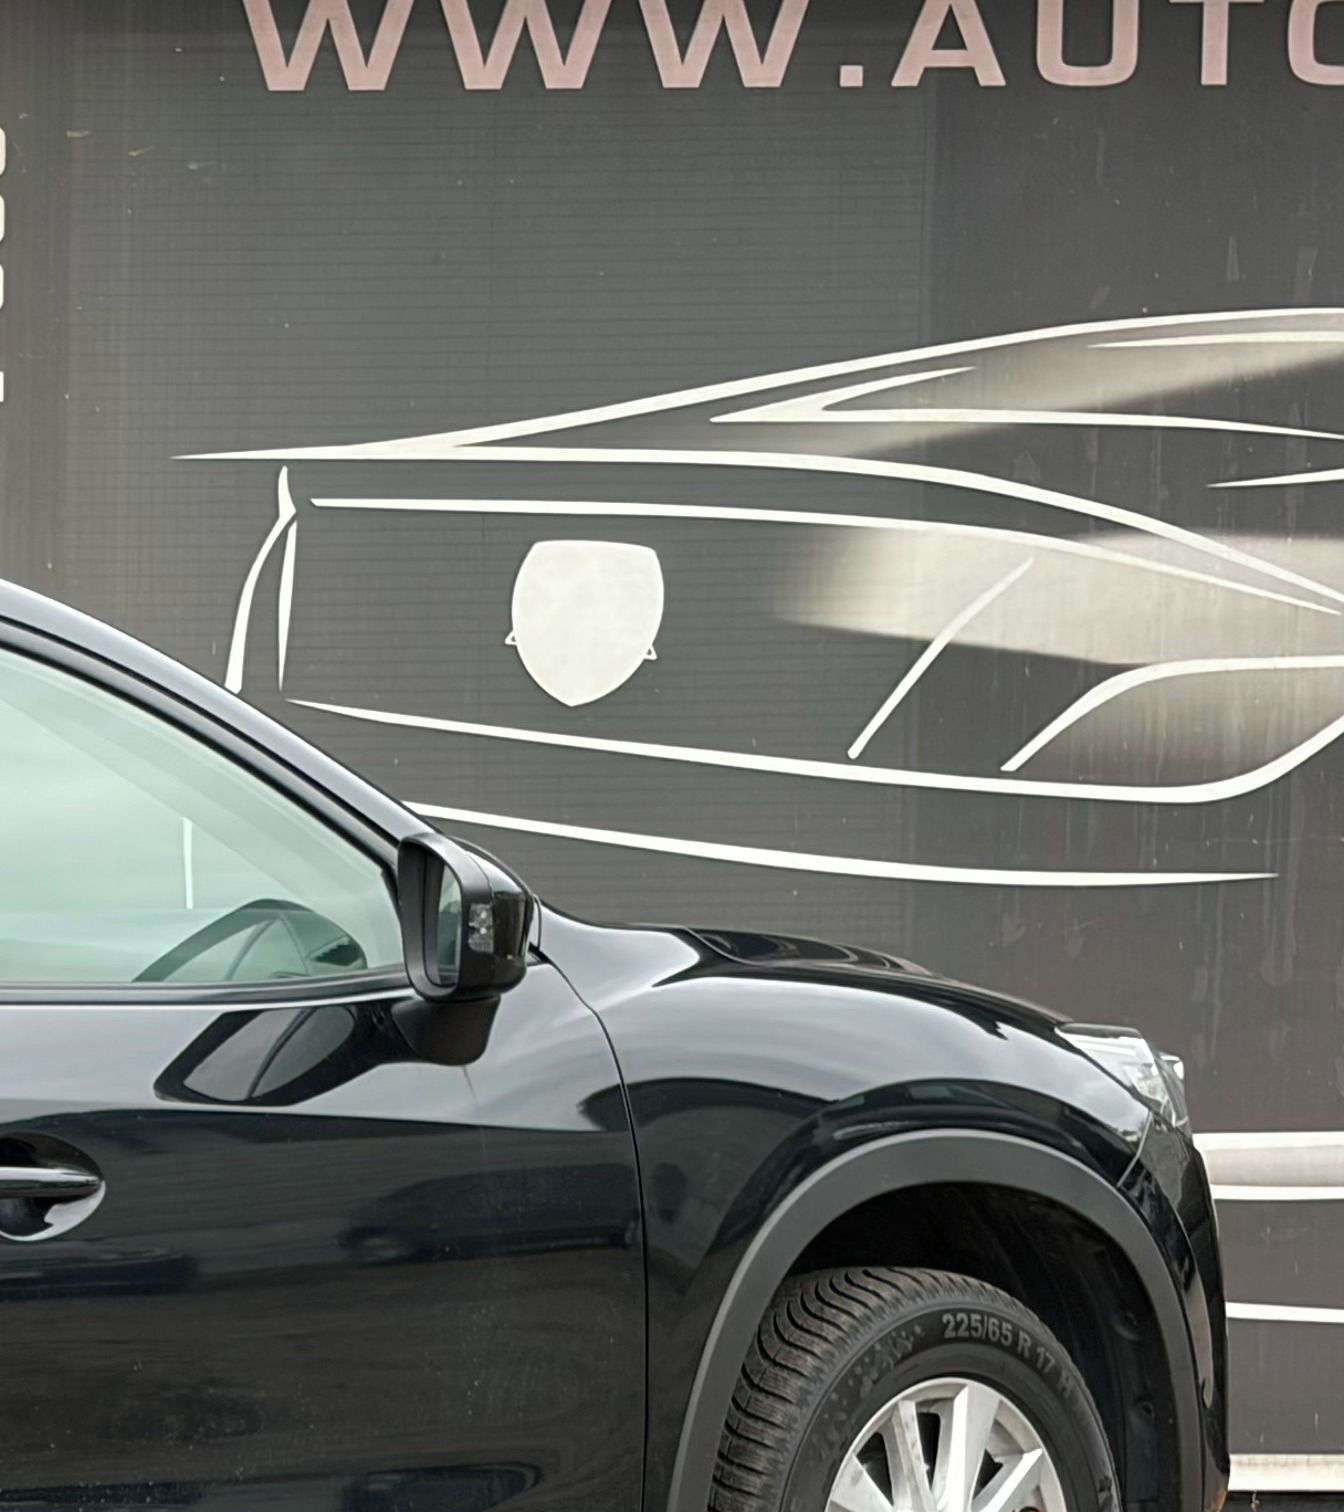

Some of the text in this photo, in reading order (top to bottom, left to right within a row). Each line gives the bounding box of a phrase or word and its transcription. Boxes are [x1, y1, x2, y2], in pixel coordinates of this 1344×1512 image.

[942, 1313, 1013, 1346] 225/65
[1018, 1330, 1032, 1358] R
[1036, 1347, 1057, 1374] 17
